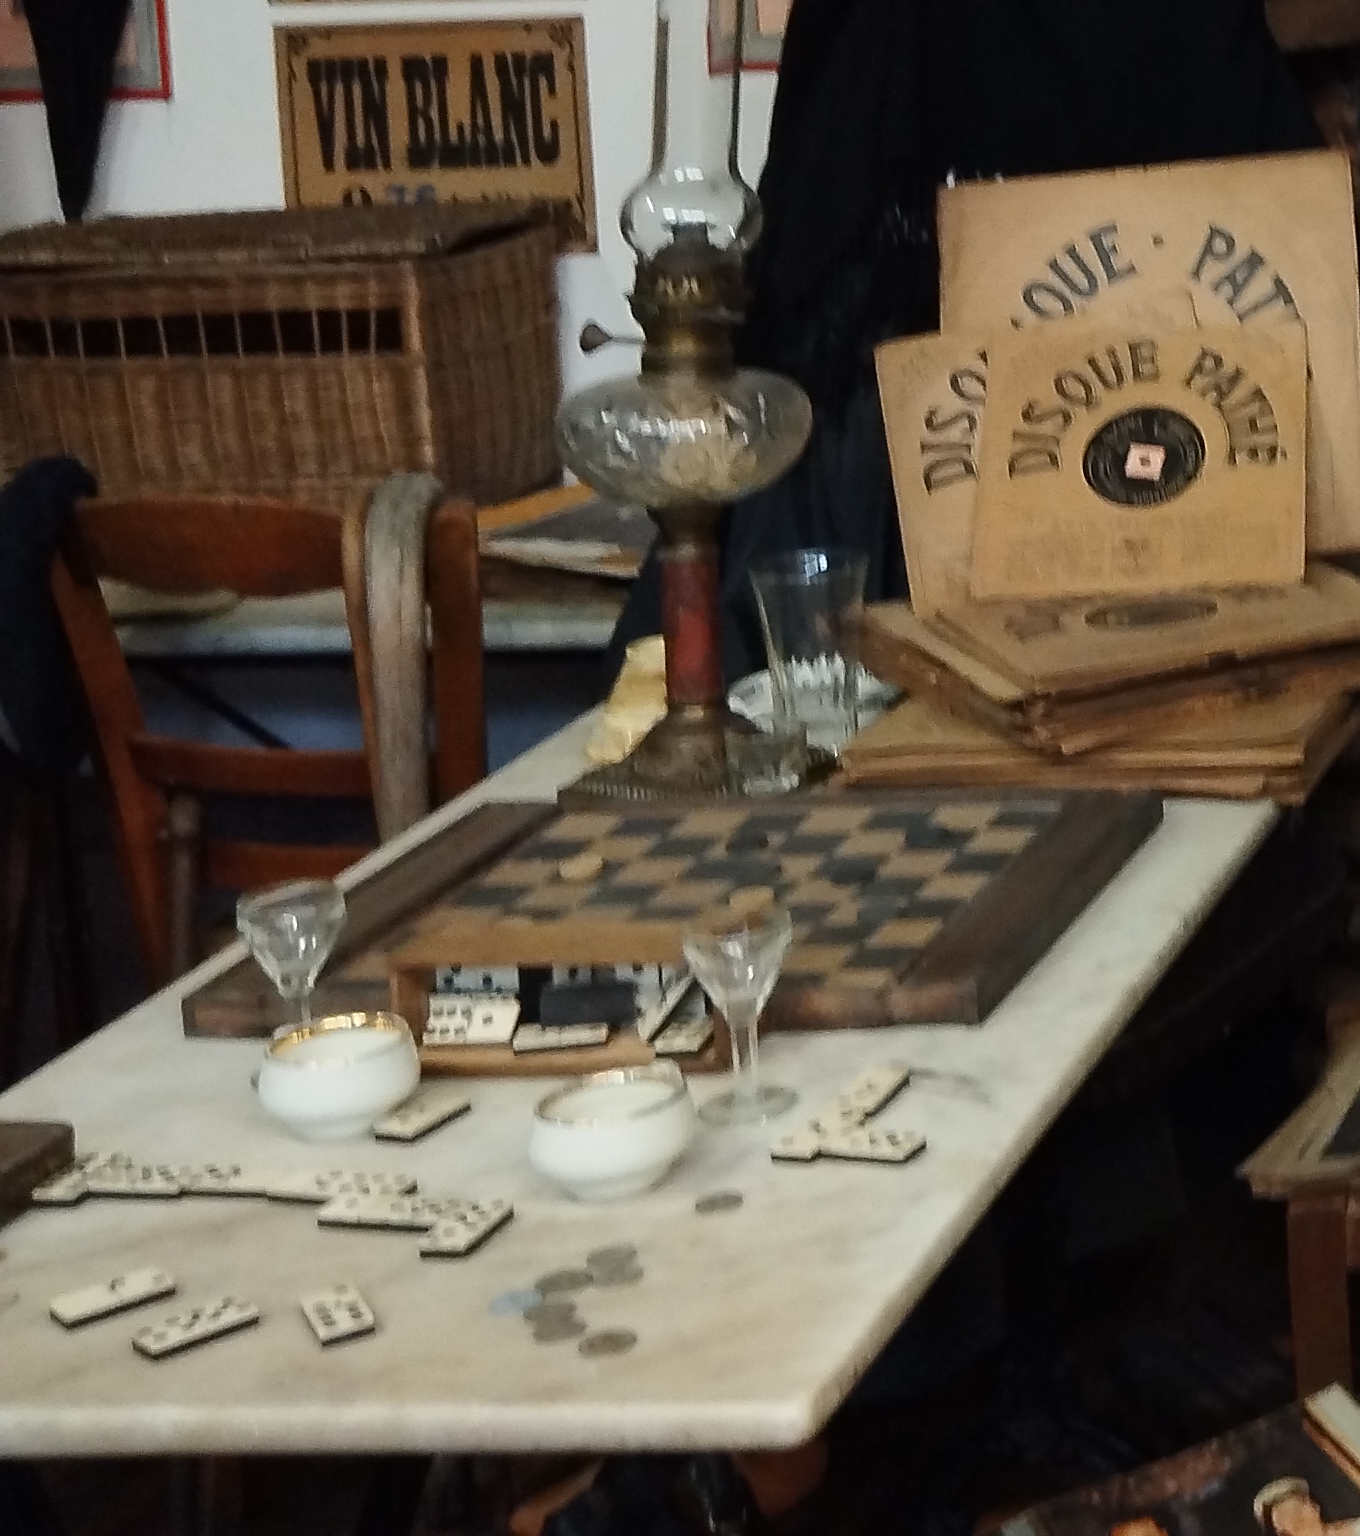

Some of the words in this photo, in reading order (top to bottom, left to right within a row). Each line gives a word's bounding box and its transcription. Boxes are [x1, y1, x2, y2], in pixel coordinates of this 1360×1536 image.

[305, 55, 393, 173] VIN
[401, 51, 562, 170] BLANC
[1018, 221, 1138, 322] QUE
[1190, 222, 1302, 325] PAT
[920, 354, 988, 496] DISQ
[1007, 339, 1161, 480] DISQUE
